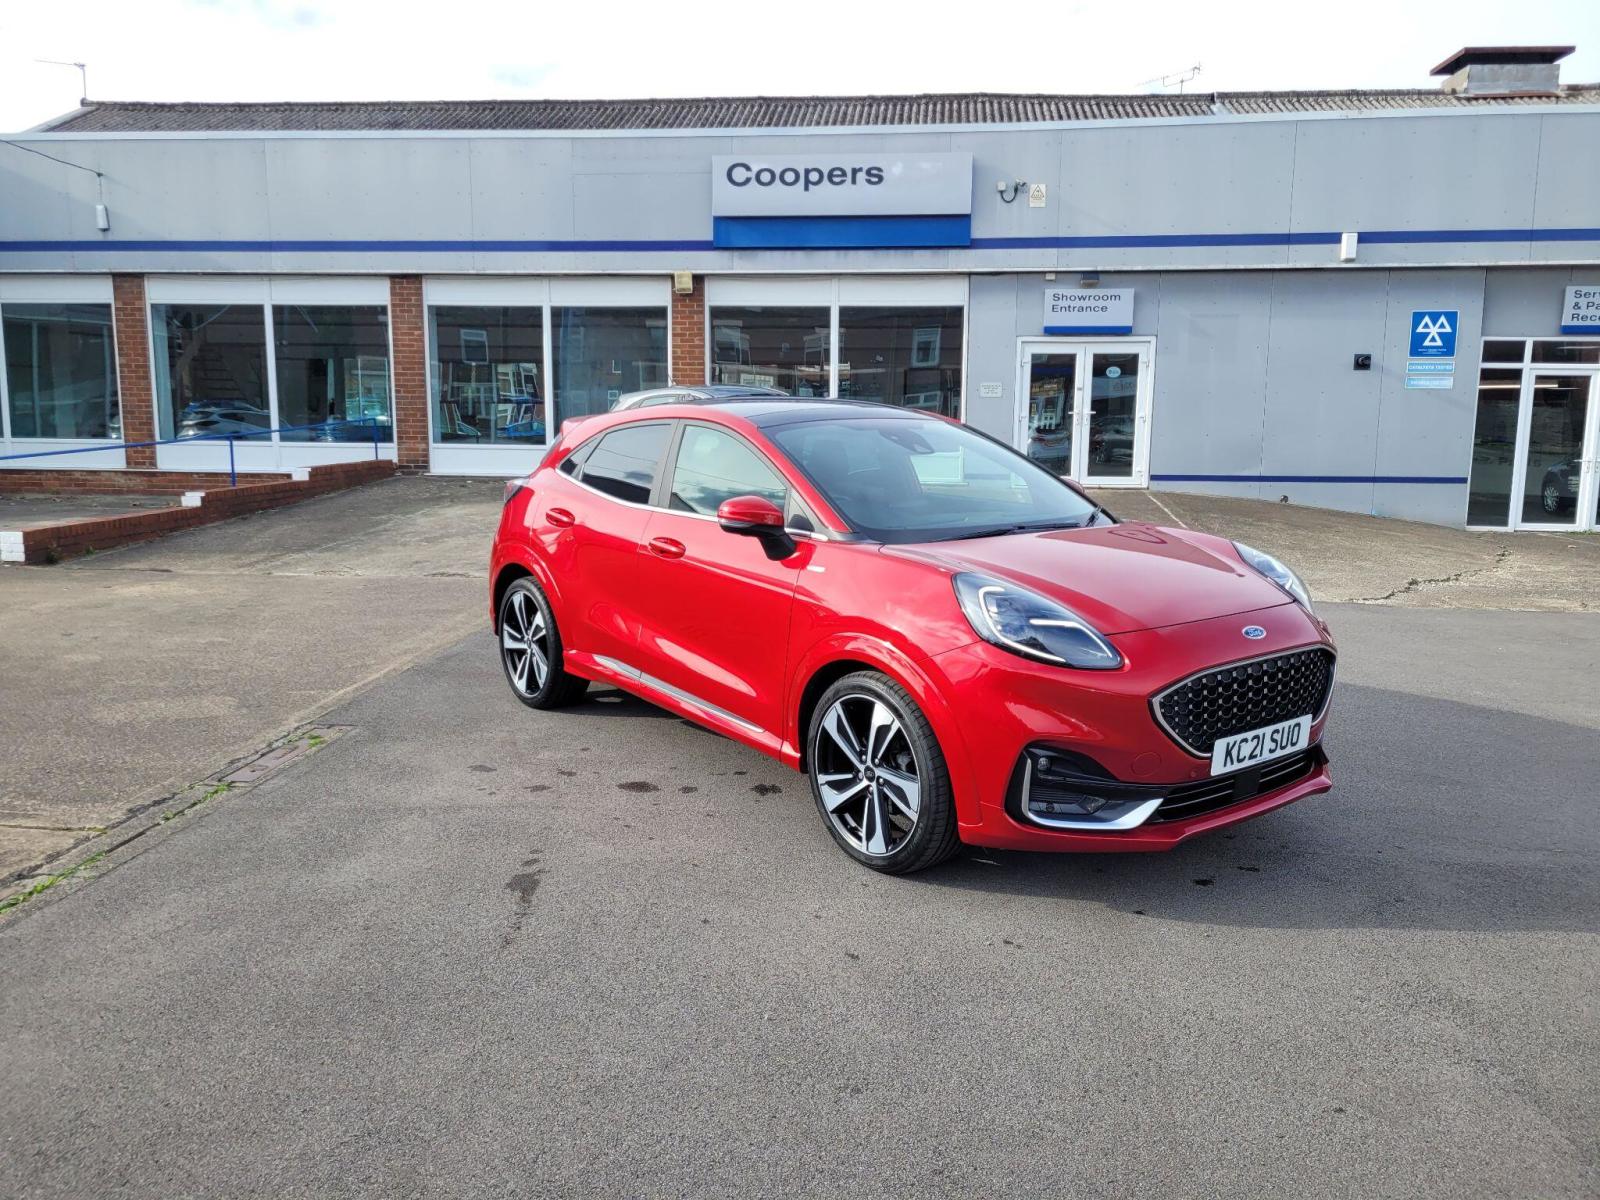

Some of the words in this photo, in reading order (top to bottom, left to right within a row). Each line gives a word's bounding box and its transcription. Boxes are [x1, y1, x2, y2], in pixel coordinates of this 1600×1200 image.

[726, 162, 884, 192] Coopers
[1052, 292, 1121, 302] Showroom
[1574, 289, 1600, 299] Ser
[1051, 304, 1109, 313] Entrance
[1572, 301, 1581, 310] &
[1571, 313, 1600, 322] Rec
[1223, 732, 1266, 768] KC21
[1268, 722, 1302, 754] SUO
